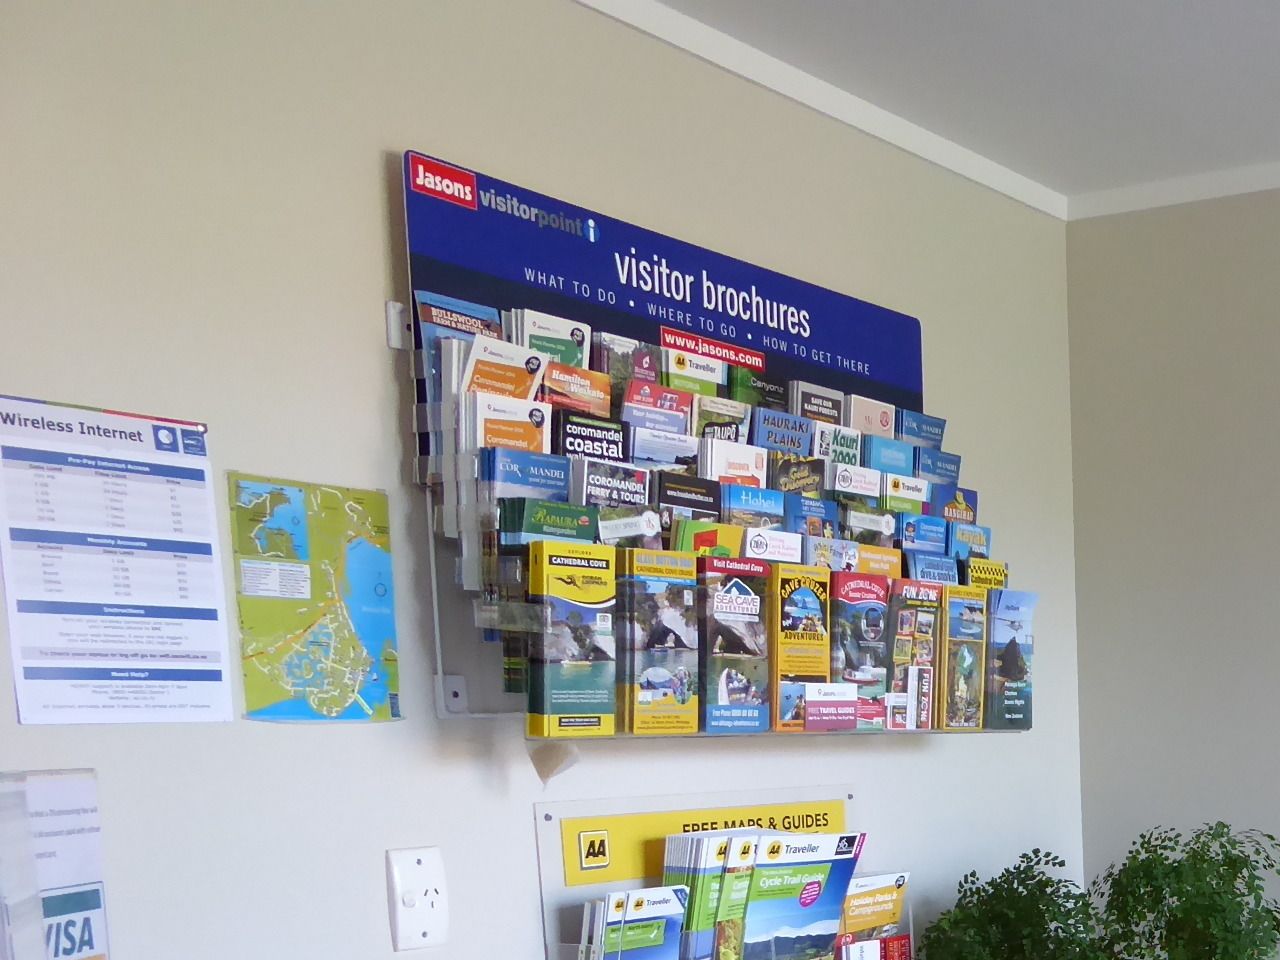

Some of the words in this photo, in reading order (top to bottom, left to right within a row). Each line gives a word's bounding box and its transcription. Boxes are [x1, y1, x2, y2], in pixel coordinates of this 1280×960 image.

[416, 165, 473, 201] Jasons
[480, 189, 583, 237] visitorpoint
[615, 247, 695, 303] visitor
[702, 270, 811, 338] brochures
[431, 306, 484, 329] BULLSWOOL
[524, 266, 565, 290] WHAT
[572, 281, 590, 298] TO
[598, 288, 616, 304] DO
[647, 302, 693, 327] WHERE
[699, 315, 714, 332] TO
[720, 322, 737, 338] GO
[763, 335, 788, 352] HOW
[792, 342, 807, 358] TO
[811, 348, 832, 365] GET
[836, 355, 871, 376] THERE
[664, 331, 763, 368] www.jasons.com
[688, 359, 717, 375] Traveller
[552, 369, 591, 386] Hamilton
[0, 411, 74, 434] Wireless
[79, 421, 144, 444] Internet
[566, 423, 623, 443] coromandel
[763, 414, 809, 434] HAURAKI
[767, 432, 802, 450] PLAINS
[832, 428, 858, 450] Kauri
[566, 437, 624, 460] coastal
[831, 450, 857, 466] 2000
[588, 473, 645, 494] COROMANDEL
[901, 481, 923, 495] Traveller
[587, 486, 610, 499] FERRY
[612, 489, 619, 500] &
[620, 491, 645, 504] TOURS
[741, 490, 775, 507] Hahei
[532, 508, 578, 528] RAPAURA
[116, 539, 148, 548] Accounts
[551, 556, 589, 567] CATHEDRAL
[589, 559, 607, 569] COVE
[713, 559, 725, 568] Visit
[725, 560, 750, 571] Cathedral
[750, 563, 764, 573] Cove
[781, 578, 800, 599] CAVE
[801, 576, 827, 601] CRUZER
[902, 585, 919, 600] FUN
[919, 588, 939, 602] ZONE
[715, 594, 736, 605] SEA
[736, 595, 759, 607] CAVE
[715, 604, 759, 615] ADVENTURES
[783, 631, 824, 642] ADVENTURES
[921, 672, 930, 696] FUN
[819, 706, 837, 715] TRAVEL
[768, 816, 778, 830] &
[782, 812, 829, 830] GUIDES
[585, 839, 607, 859] AA
[785, 843, 820, 855] Traveller
[759, 876, 781, 889] Cycle
[782, 874, 801, 886] Trail
[646, 898, 672, 907] Traveller
[850, 895, 875, 908] Holiday
